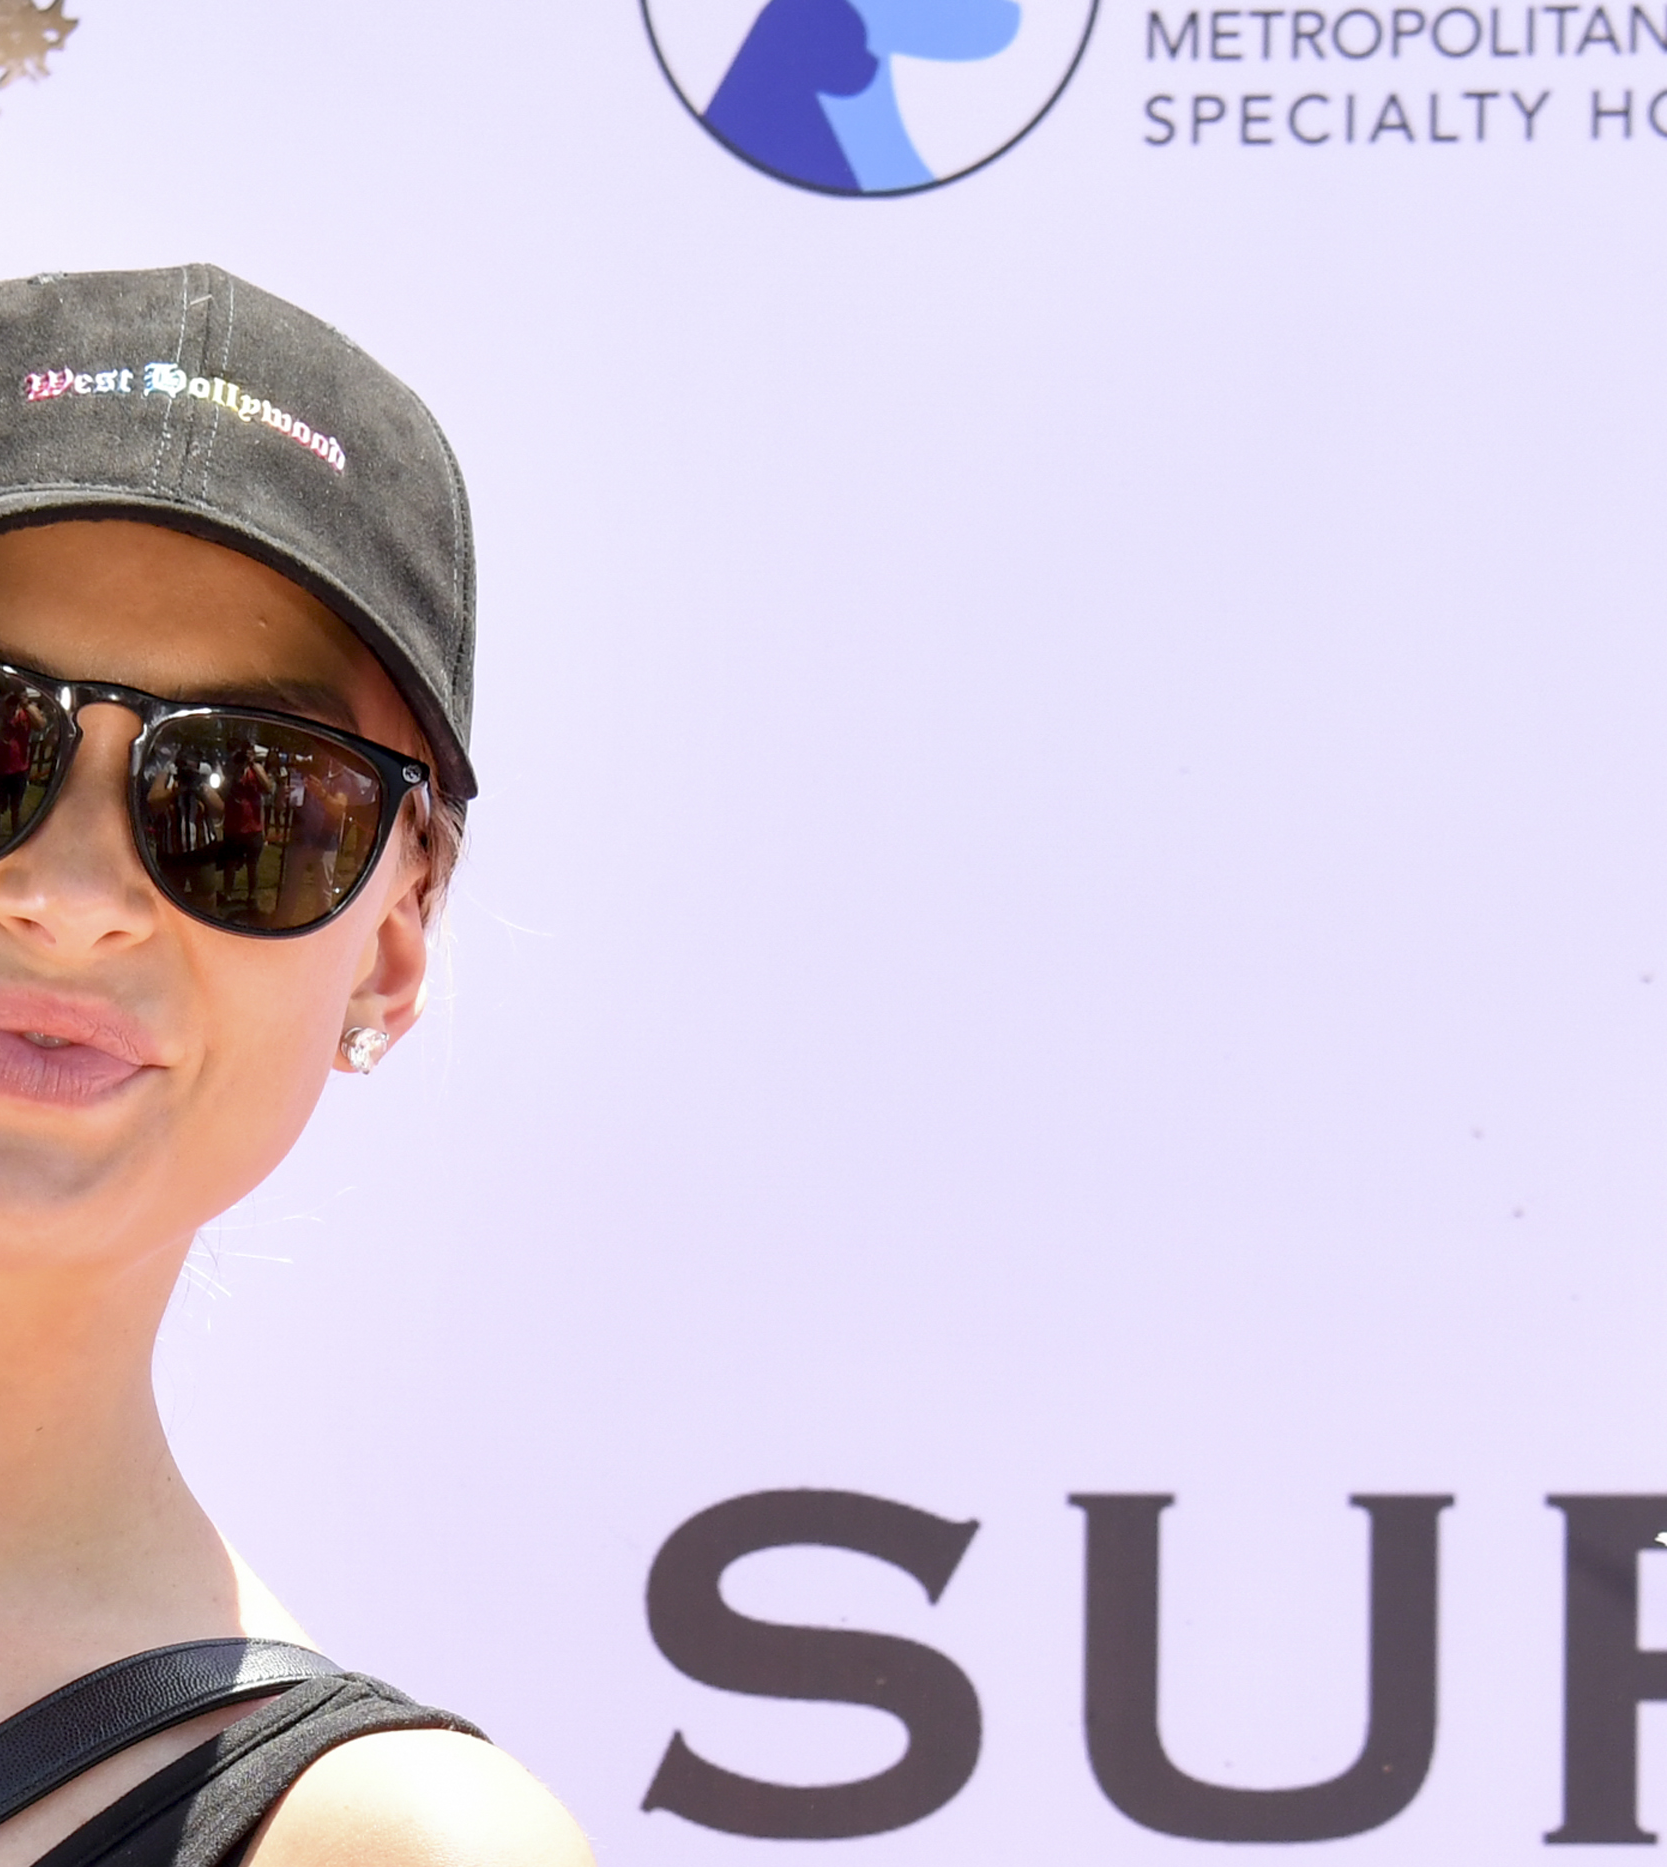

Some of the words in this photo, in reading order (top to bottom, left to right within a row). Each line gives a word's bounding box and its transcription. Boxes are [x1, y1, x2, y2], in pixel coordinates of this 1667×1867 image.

[1145, 4, 1667, 62] METROPOLITAN
[1144, 90, 1551, 147] SPECIALTY
[24, 366, 135, 402] West
[142, 361, 348, 475] Hollywood
